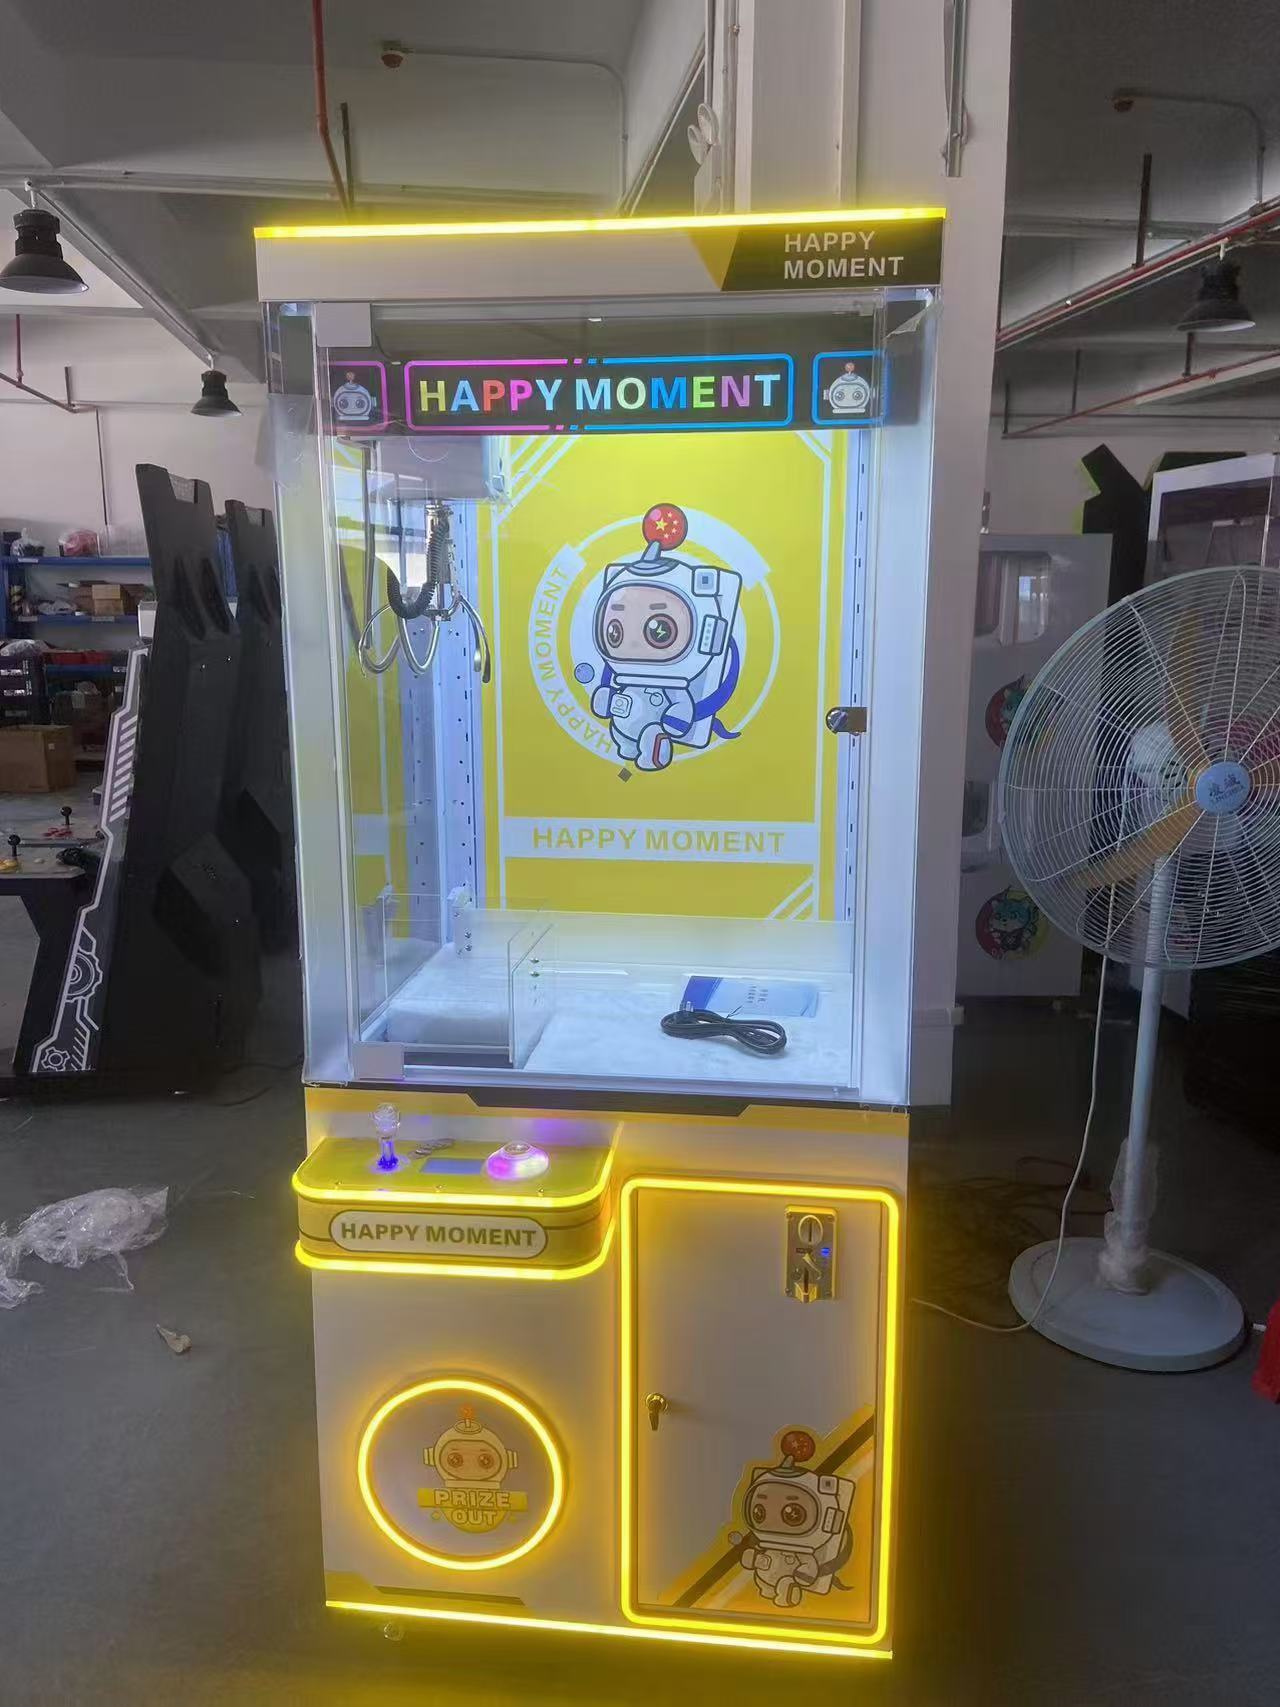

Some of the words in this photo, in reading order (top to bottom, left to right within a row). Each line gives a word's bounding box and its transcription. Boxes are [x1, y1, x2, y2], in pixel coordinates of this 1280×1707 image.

[784, 231, 876, 253] HAPPY
[784, 256, 904, 279] MOMENT
[419, 378, 563, 412] HAPPY
[575, 374, 781, 411] MOMENT
[535, 567, 569, 682] MOMENT
[546, 689, 613, 754] HAPPY
[532, 826, 638, 850] HAPPY
[645, 828, 785, 854] MOMENT
[341, 1222, 421, 1241] HAPPY
[426, 1225, 537, 1247] MOMENT
[433, 1488, 511, 1508] PRIZE
[451, 1507, 497, 1526] OUT
